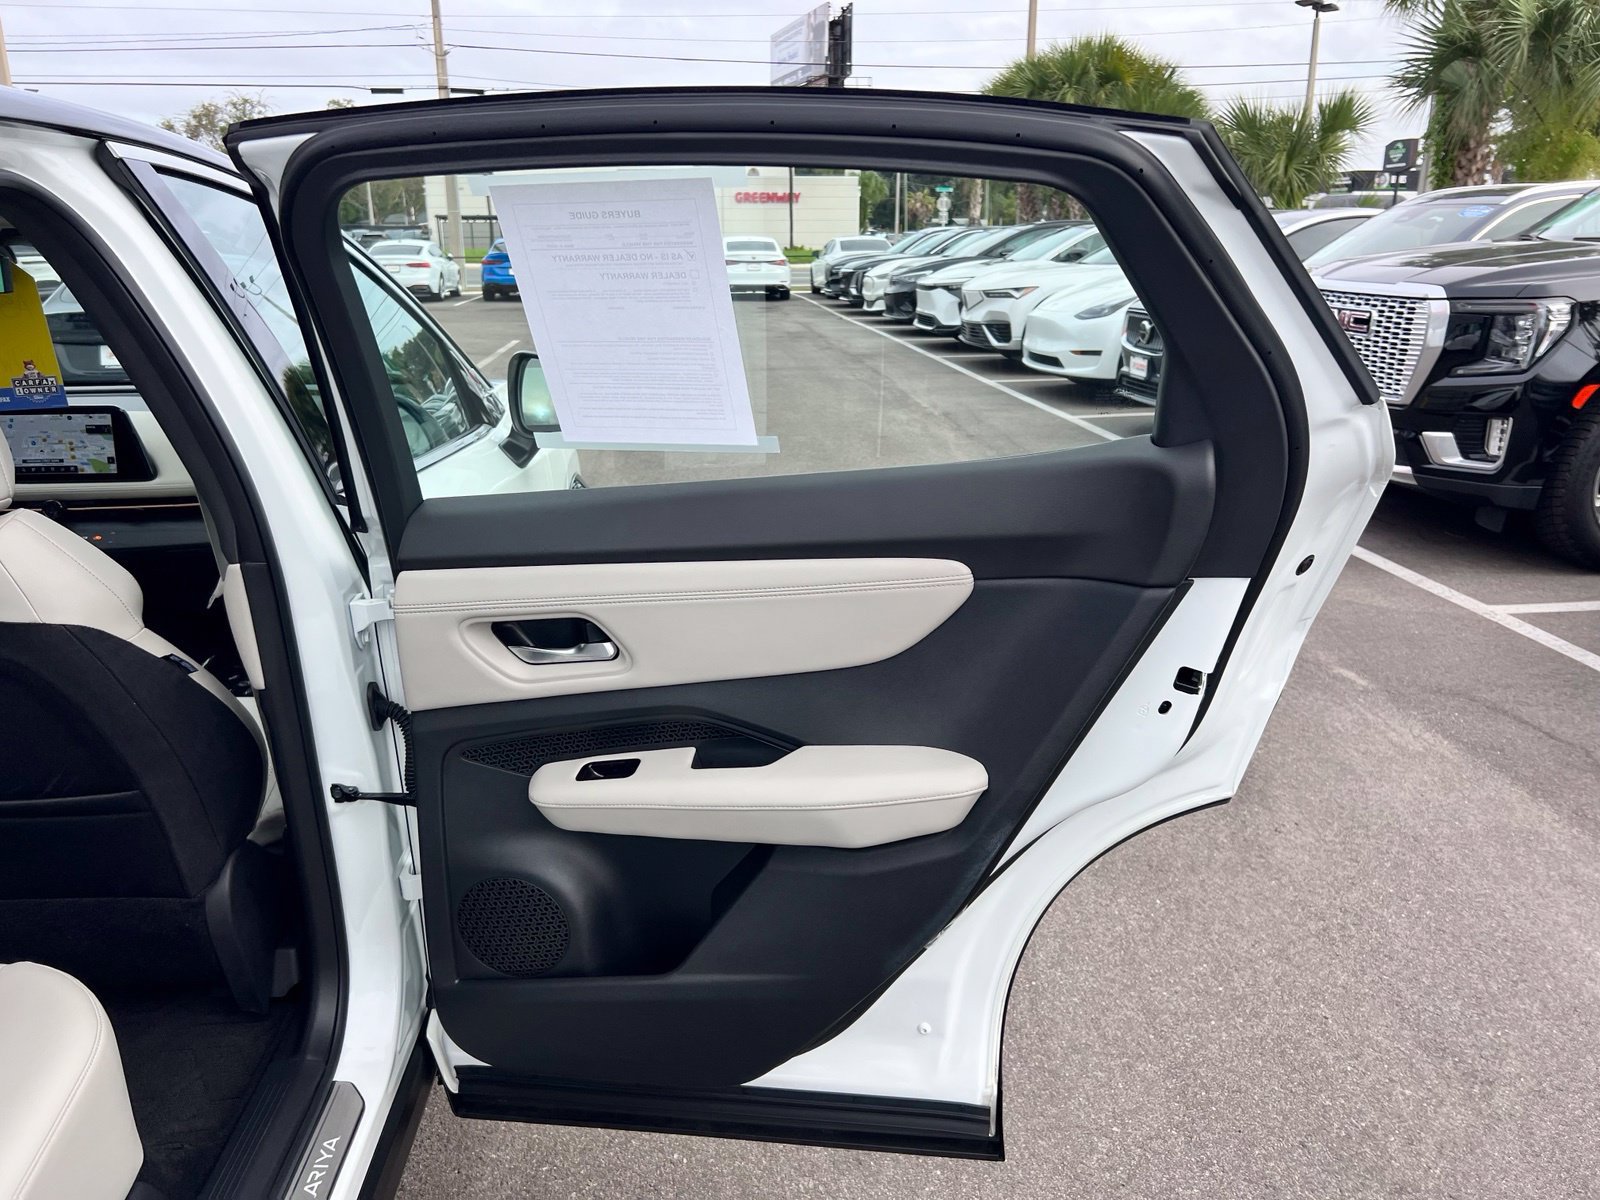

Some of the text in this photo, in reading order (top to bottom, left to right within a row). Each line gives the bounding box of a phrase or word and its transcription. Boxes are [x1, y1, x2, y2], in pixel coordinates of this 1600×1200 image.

[735, 191, 801, 204] GREENWAY
[1334, 309, 1370, 332] MC
[14, 378, 56, 387] CARFAX
[303, 1136, 341, 1198] ARIYA
